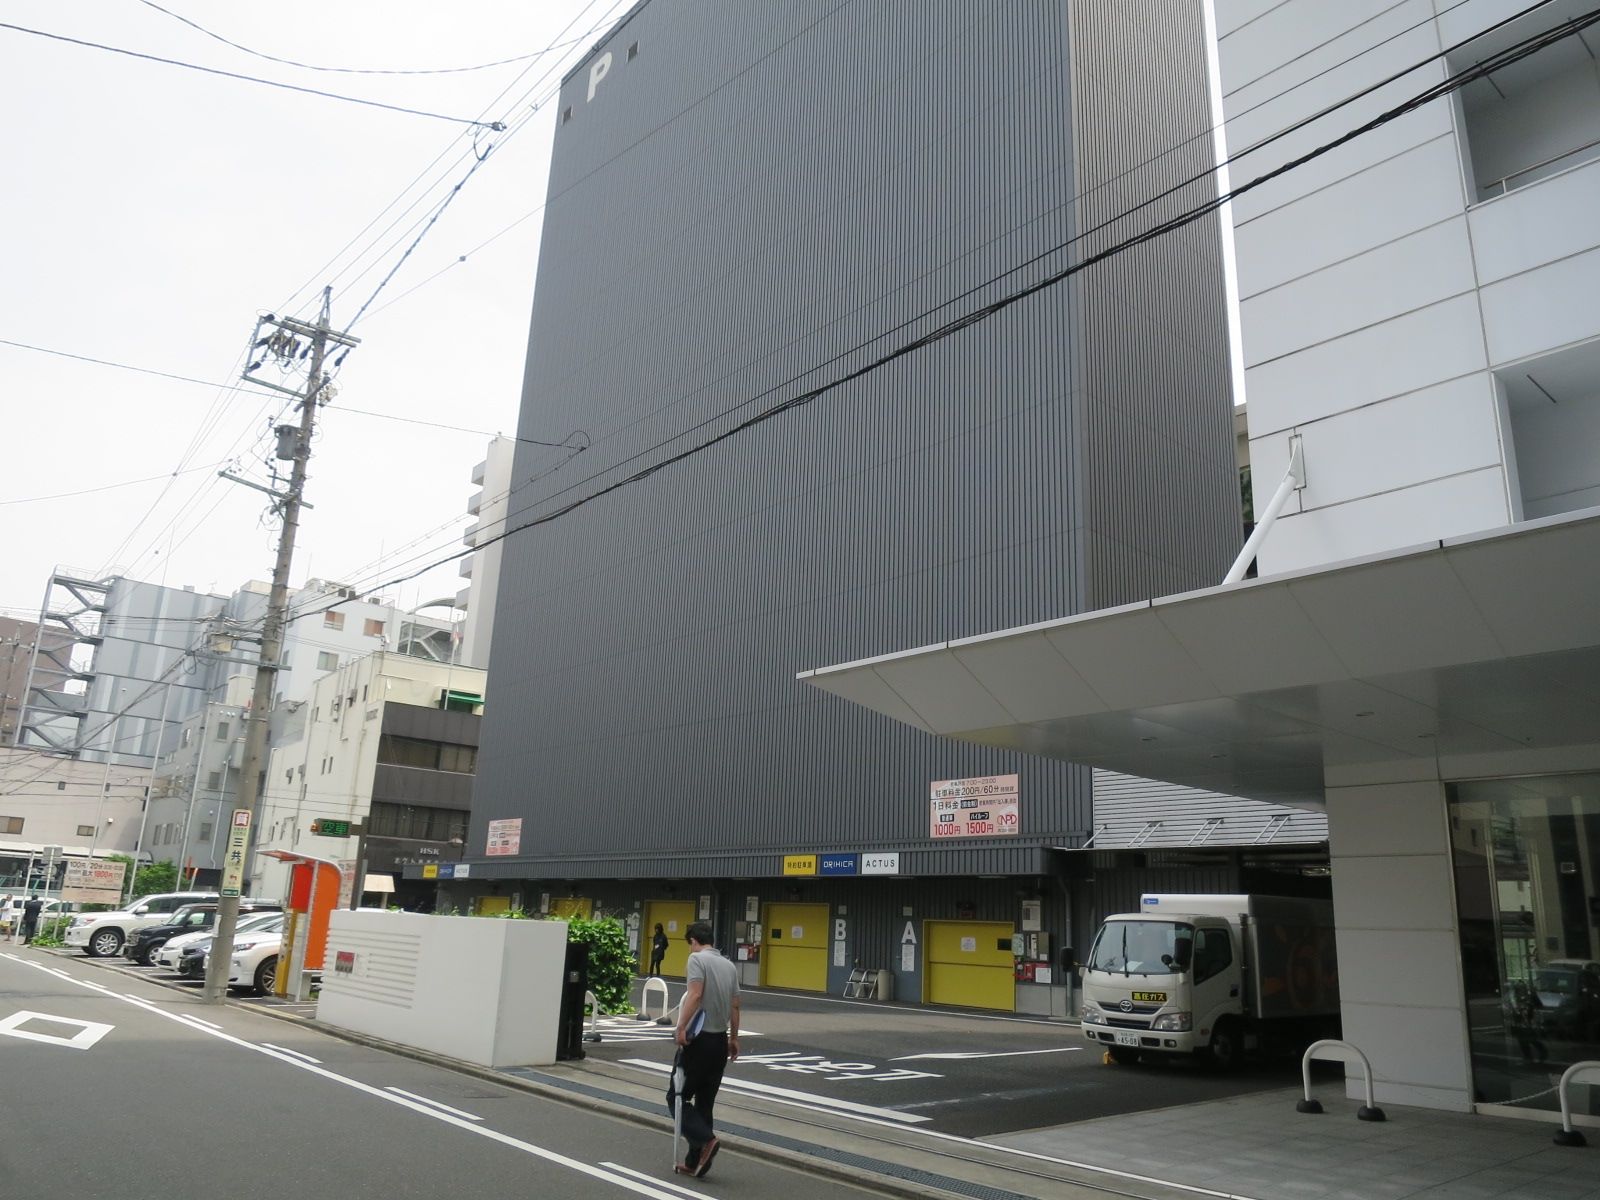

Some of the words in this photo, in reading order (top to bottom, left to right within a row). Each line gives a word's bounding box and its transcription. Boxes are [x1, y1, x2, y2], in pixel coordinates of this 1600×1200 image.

[586, 52, 613, 103] P
[321, 822, 347, 835] 空車
[934, 823, 961, 835] 1000円
[966, 822, 993, 834] 1500円
[419, 847, 440, 855] HSK
[866, 859, 895, 867] ACTUS
[835, 918, 846, 941] B
[901, 920, 917, 944] A
